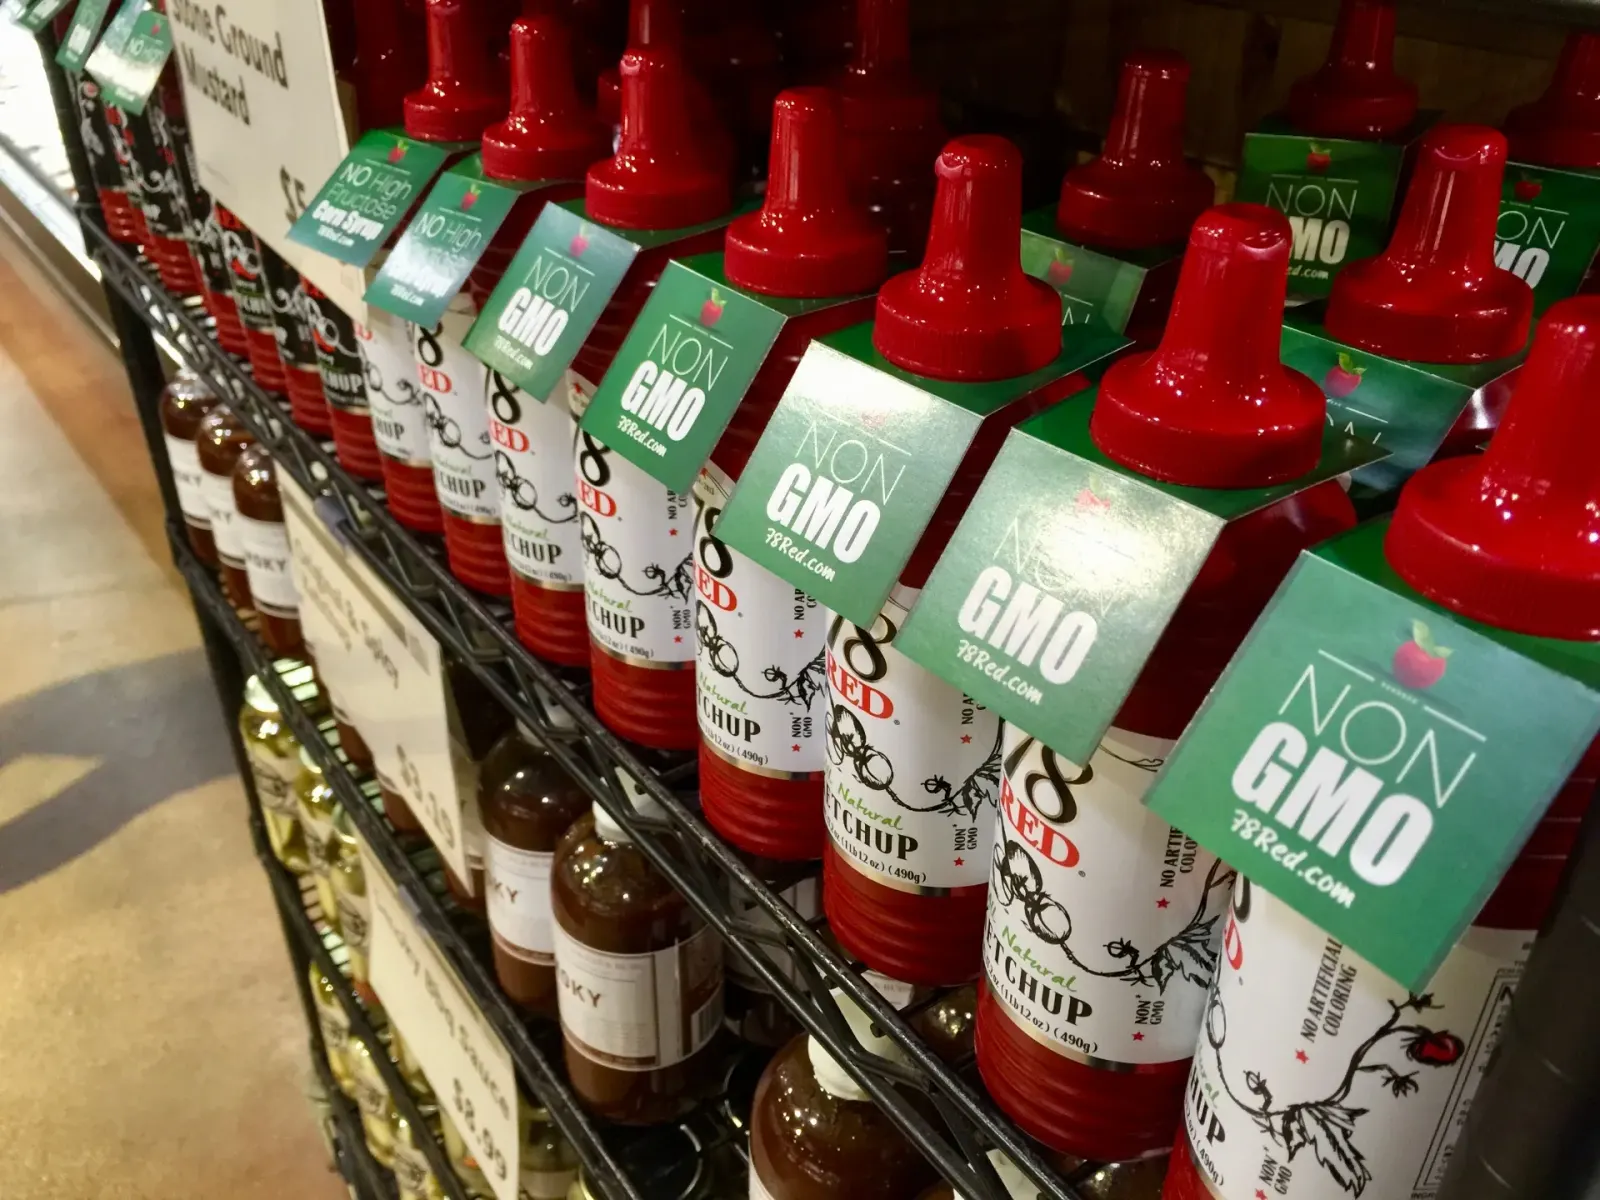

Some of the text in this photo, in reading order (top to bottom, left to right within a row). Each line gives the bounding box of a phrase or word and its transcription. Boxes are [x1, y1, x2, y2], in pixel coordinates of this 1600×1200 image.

[215, 4, 288, 90] Ground
[181, 41, 250, 126] Mustard
[340, 162, 412, 203] NO High
[1266, 182, 1357, 220] NON
[415, 211, 446, 238] NO
[1289, 215, 1350, 264] MO
[1497, 210, 1565, 249] ON
[523, 255, 591, 313] NON
[497, 286, 569, 357] GMO
[419, 364, 452, 394] ED
[647, 323, 729, 392] NON
[620, 360, 706, 441] GMO
[490, 419, 530, 453] ED
[794, 419, 907, 506] NON
[579, 478, 617, 518] ED
[766, 462, 881, 564] GMO
[508, 533, 562, 565] CHUP
[764, 527, 837, 583] 78Red.com
[695, 562, 738, 612] ED
[793, 605, 805, 621] NO
[591, 600, 645, 639] CHUP
[957, 565, 1098, 685] GMO
[956, 639, 1043, 706] 78Red.com
[699, 692, 761, 743] CHUP
[802, 716, 813, 739] GMO
[961, 708, 974, 725] NO
[1278, 663, 1477, 809] NON
[824, 784, 919, 861] ETCHUP
[837, 782, 904, 831] Natural
[1000, 774, 1080, 868] RED
[1231, 721, 1434, 887] GMO
[966, 827, 978, 851] GMO
[1160, 824, 1183, 888] NO ARTIF
[1179, 836, 1199, 874] COLO
[1230, 808, 1357, 909] 78Red.com
[984, 916, 1093, 1027] ETCHUP
[1001, 925, 1077, 993] Natural
[1149, 1000, 1165, 1025] GMO
[1300, 936, 1344, 1044] NO ARTIFICIAL
[1322, 963, 1358, 1037] COLORING
[1273, 1164, 1293, 1196] GMO
